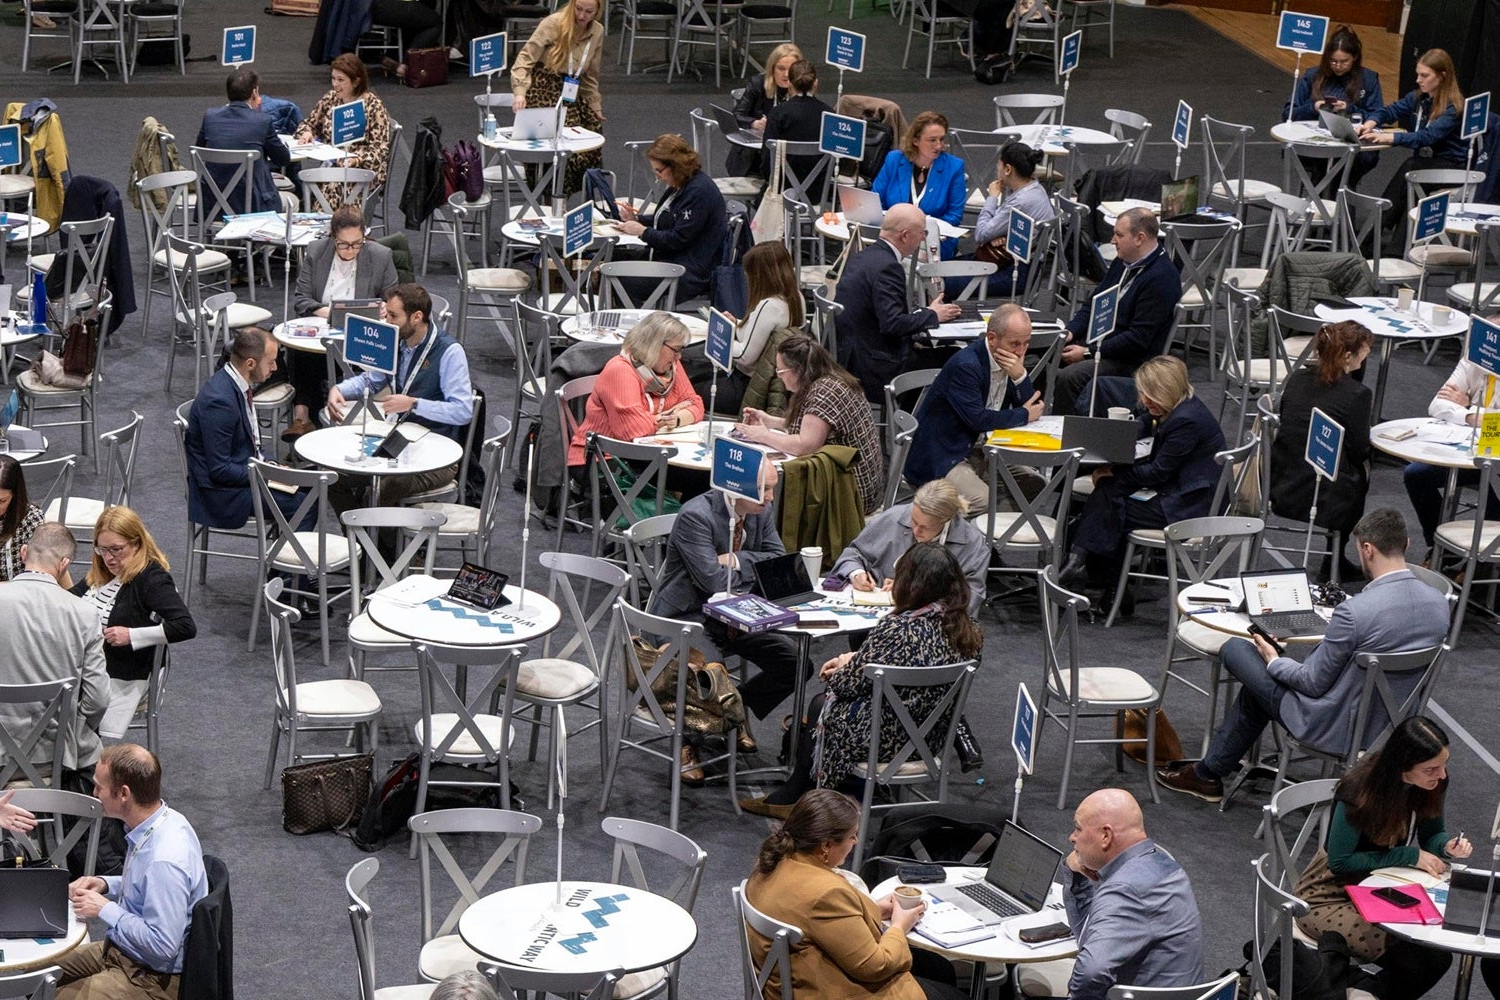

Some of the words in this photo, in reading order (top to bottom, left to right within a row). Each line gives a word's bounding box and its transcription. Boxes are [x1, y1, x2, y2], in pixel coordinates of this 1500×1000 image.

[1297, 20, 1311, 29] 145
[234, 33, 244, 41] 101
[840, 36, 852, 45] 123
[481, 41, 492, 51] 122
[343, 109, 355, 119] 102
[838, 122, 851, 132] 124
[1430, 201, 1440, 212] 142
[574, 213, 584, 224] 120
[363, 326, 379, 339] 104
[1486, 330, 1497, 343] 141
[375, 342, 387, 350] Lodge
[1321, 425, 1332, 439] 127
[729, 448, 742, 461] 118
[565, 889, 592, 908] WILD
[519, 945, 545, 963] WAY
